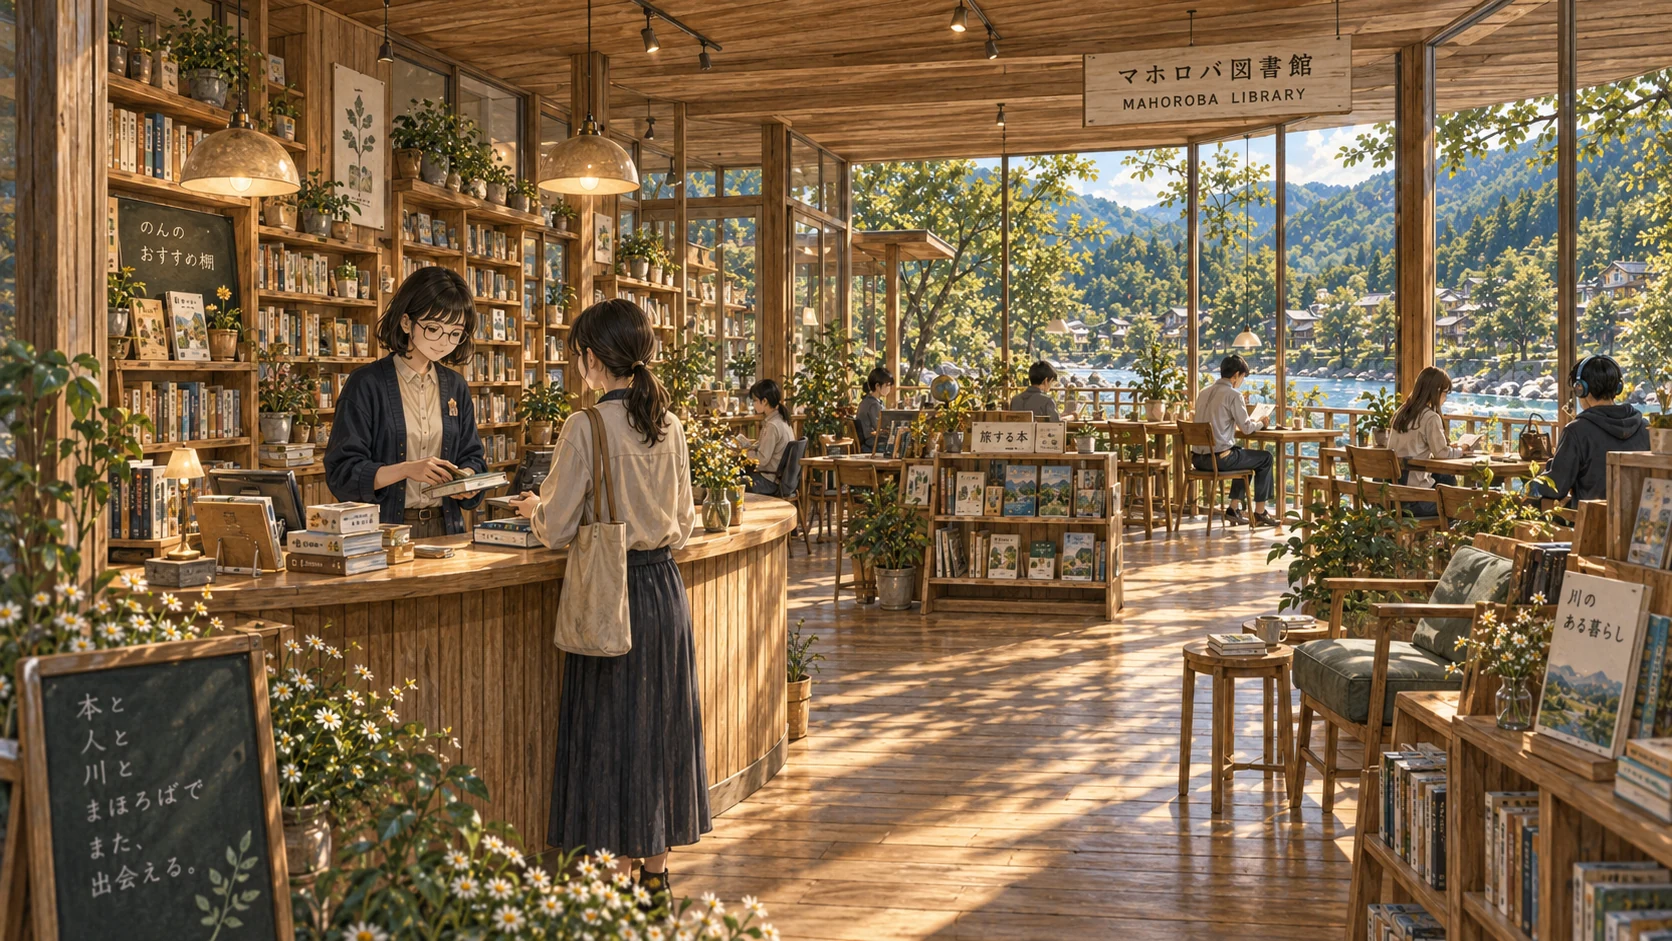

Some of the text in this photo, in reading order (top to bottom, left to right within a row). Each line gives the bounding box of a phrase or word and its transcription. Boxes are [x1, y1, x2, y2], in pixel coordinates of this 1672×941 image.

[1118, 53, 1313, 85] マホロバ図書館
[1122, 88, 1306, 110] MAHOROBA LIBRARY
[140, 221, 185, 239] のんの
[979, 430, 1029, 444] 旅する本
[1567, 588, 1596, 608] 川の
[1563, 613, 1624, 643] ある暮らし
[76, 693, 125, 721] 本と
[81, 729, 129, 755] 人と
[83, 760, 133, 786] 川と
[86, 779, 204, 823] まほろばで
[89, 832, 143, 860] また、
[91, 856, 195, 899] 出会える。
